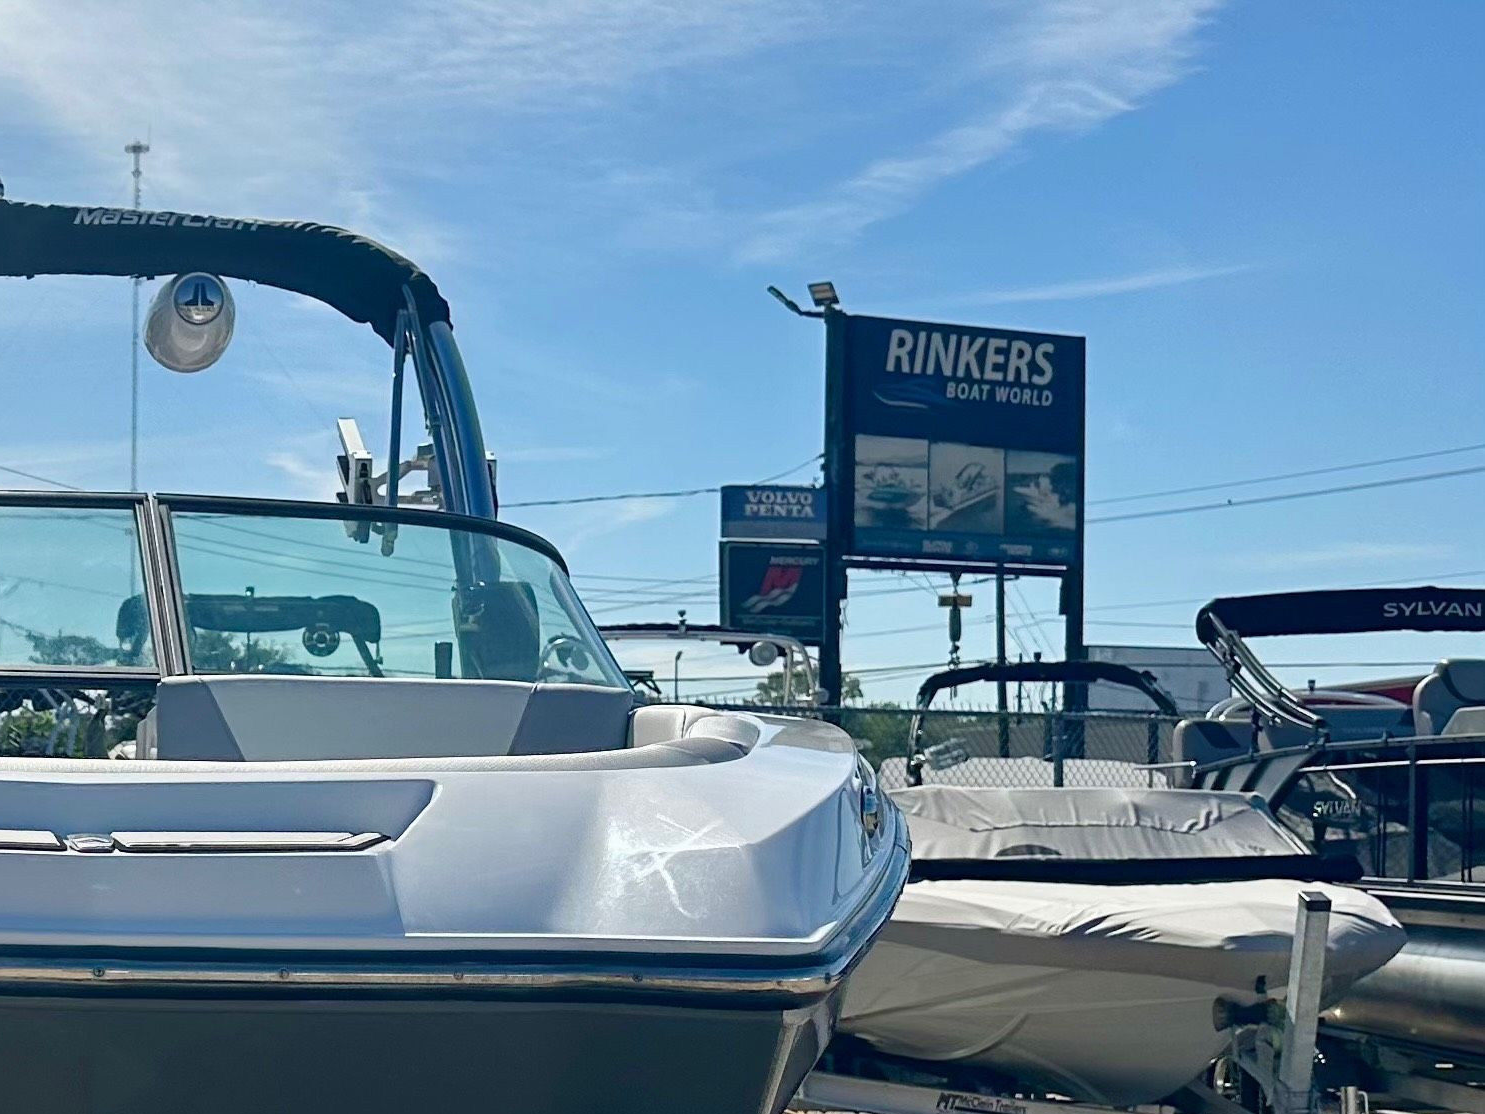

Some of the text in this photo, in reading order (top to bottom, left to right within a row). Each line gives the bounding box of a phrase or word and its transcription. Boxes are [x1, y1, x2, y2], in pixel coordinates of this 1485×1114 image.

[885, 328, 1055, 386] RINKERS
[946, 382, 1053, 407] BOAT WORLD
[745, 490, 813, 504] VOLVO
[744, 503, 815, 518] PENTA
[1382, 601, 1482, 618] SYLVAN
[1312, 800, 1362, 818] SYLVAN
